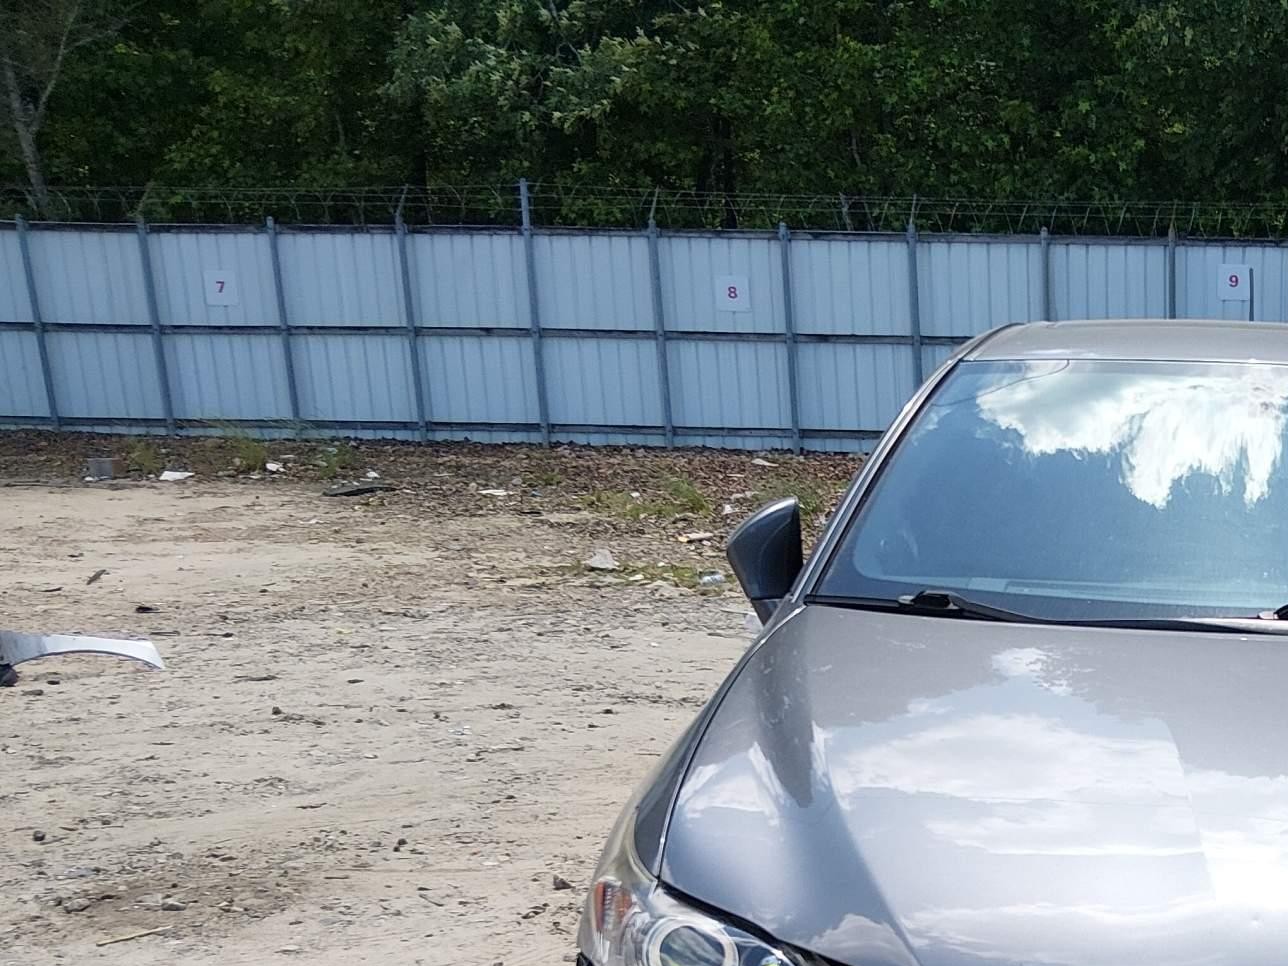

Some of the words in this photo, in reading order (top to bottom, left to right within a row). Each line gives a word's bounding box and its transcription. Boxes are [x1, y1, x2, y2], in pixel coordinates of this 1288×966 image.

[215, 280, 226, 294] 7
[1228, 274, 1240, 288] 9
[727, 285, 738, 299] 8
